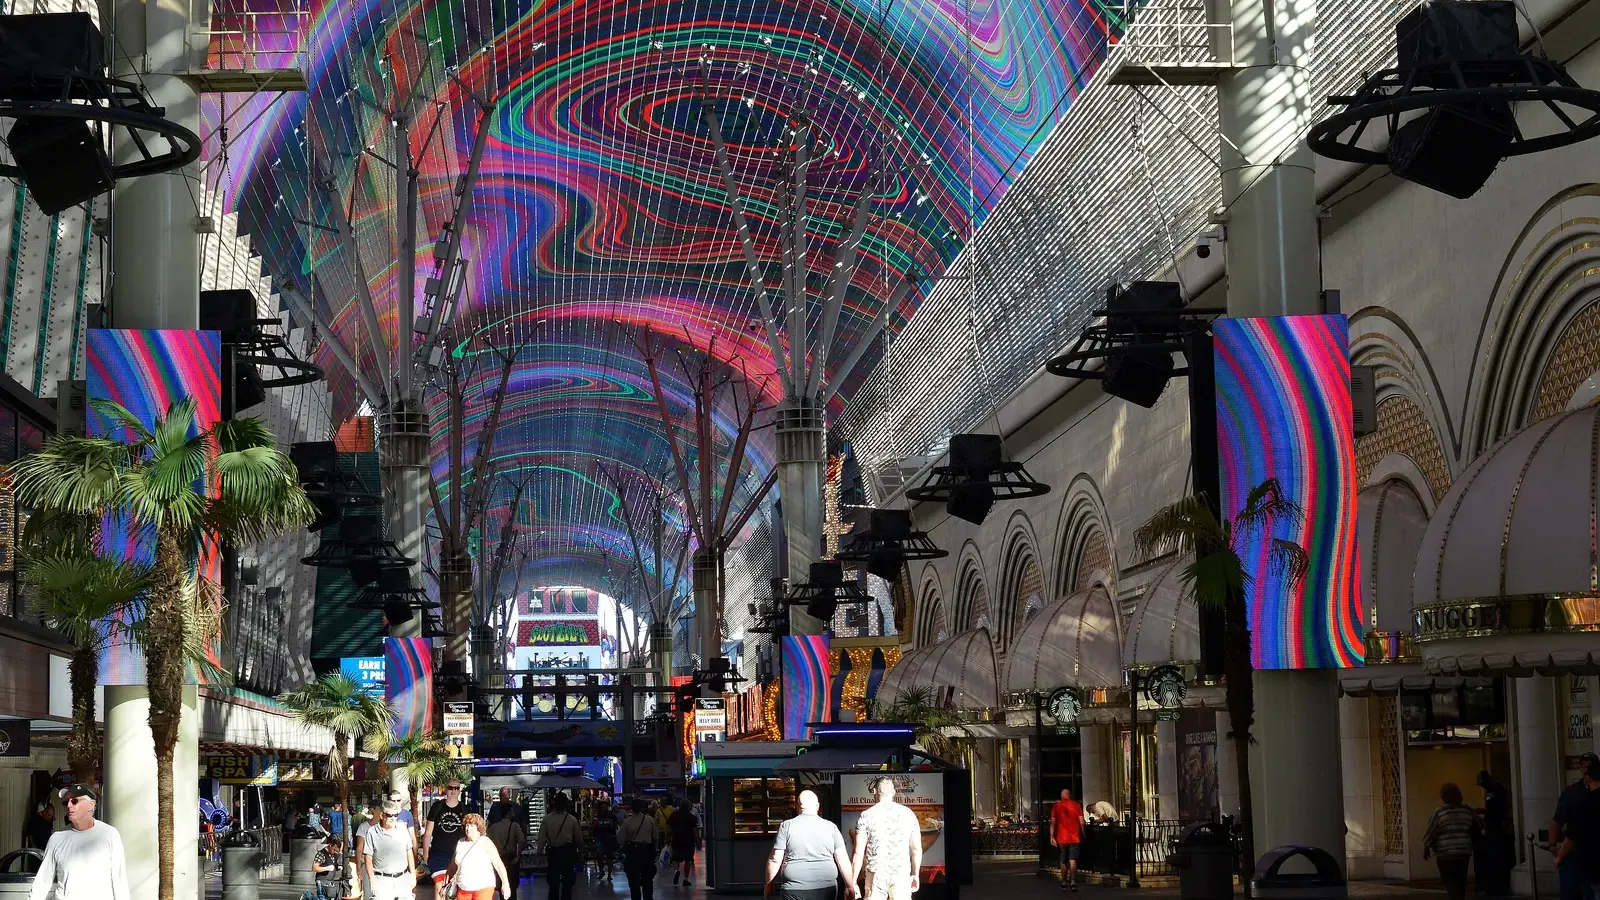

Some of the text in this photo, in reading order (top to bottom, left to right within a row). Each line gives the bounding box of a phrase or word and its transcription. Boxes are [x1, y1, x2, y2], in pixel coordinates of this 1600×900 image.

[1424, 607, 1509, 632] NUGGE
[358, 660, 381, 670] EARN
[362, 671, 368, 680] 3
[1570, 714, 1589, 726] COMP
[209, 757, 249, 767] FISH
[212, 767, 247, 778] SPA
[820, 772, 834, 780] BUY
